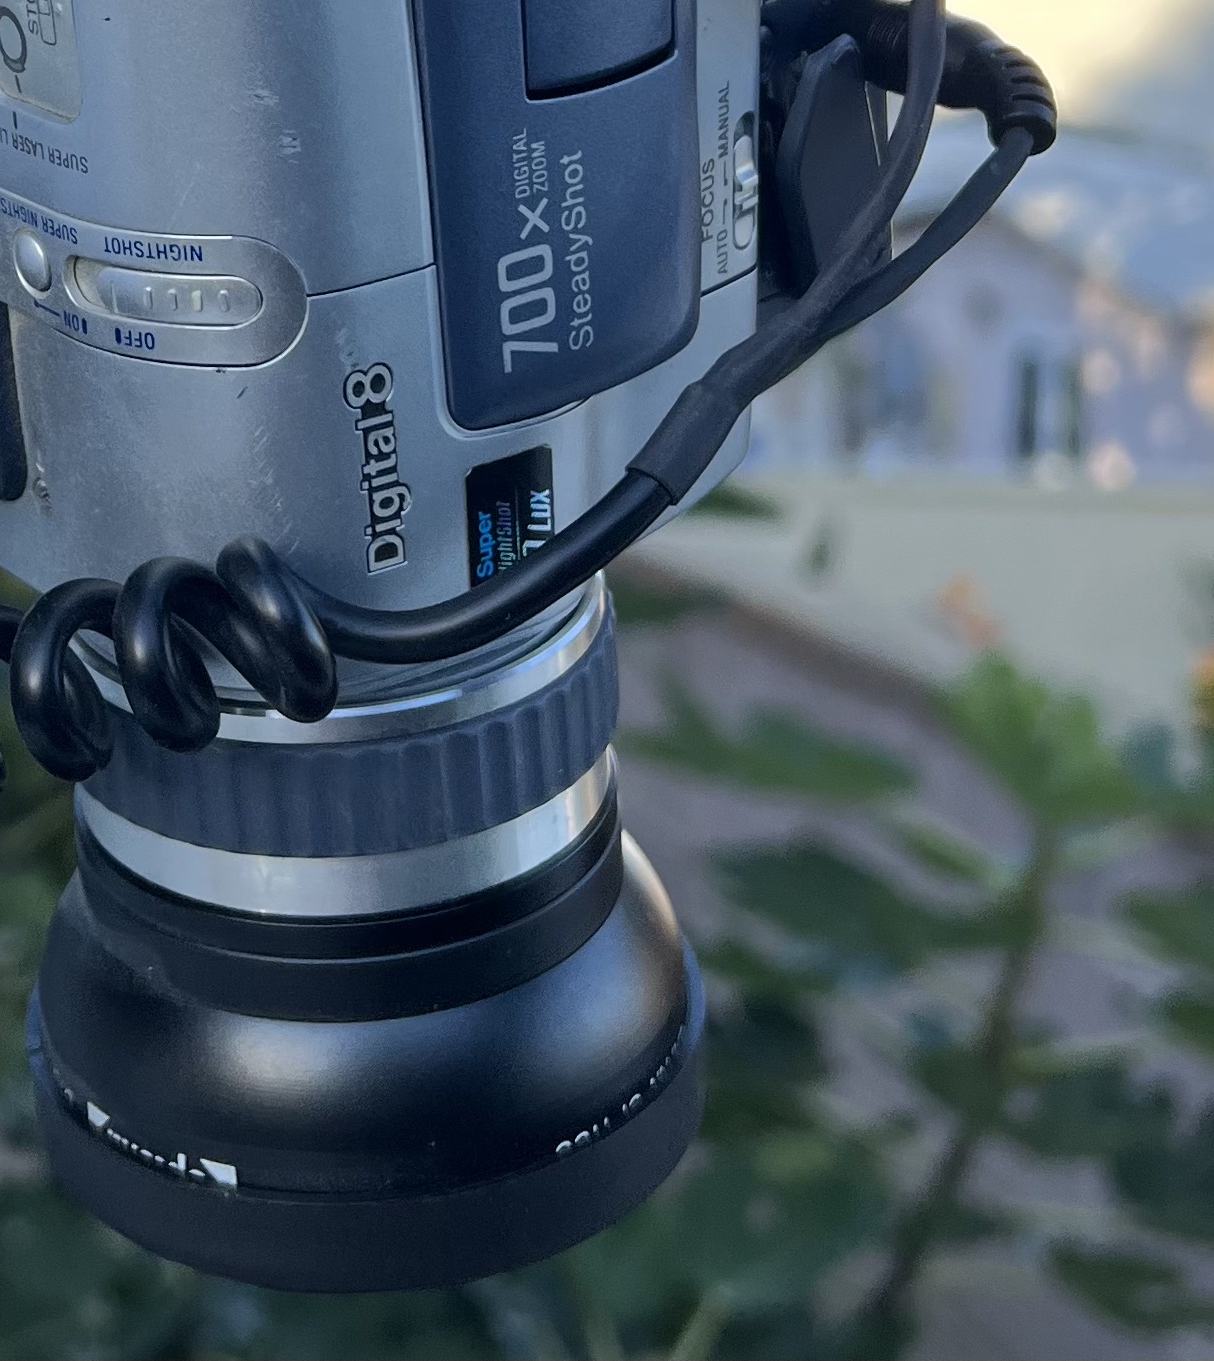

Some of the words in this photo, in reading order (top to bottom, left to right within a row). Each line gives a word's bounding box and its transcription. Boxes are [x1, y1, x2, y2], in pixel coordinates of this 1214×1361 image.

[717, 82, 731, 157] MANUAL
[12, 133, 44, 160] LASER
[48, 147, 88, 174] SUPER
[512, 128, 530, 199] DIGITAL
[530, 140, 549, 193] ZOOM
[701, 159, 716, 242] FOCUS
[42, 217, 77, 244] SUPER
[104, 237, 202, 261] NIGHTSHOT
[559, 150, 595, 350] SteadyShot
[716, 228, 730, 274] AUTO
[63, 310, 79, 330] ON
[124, 331, 155, 350] OFF
[475, 511, 496, 577] Super
